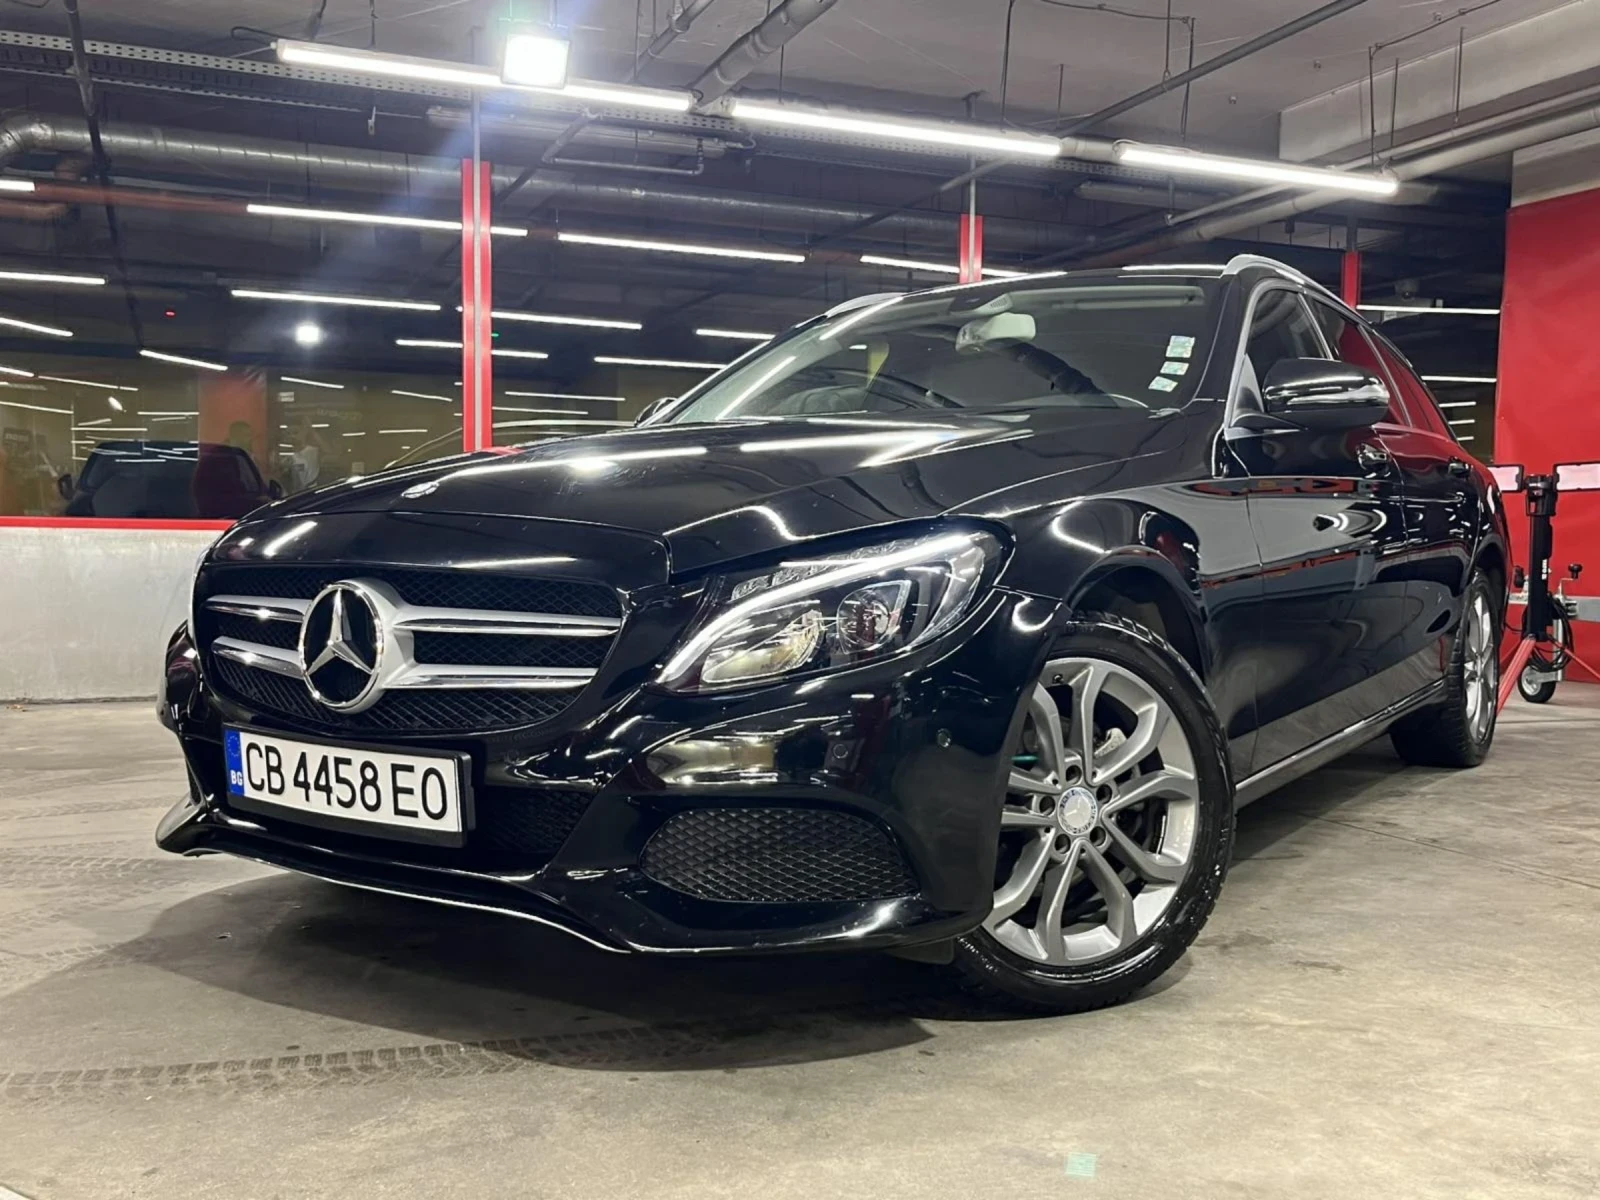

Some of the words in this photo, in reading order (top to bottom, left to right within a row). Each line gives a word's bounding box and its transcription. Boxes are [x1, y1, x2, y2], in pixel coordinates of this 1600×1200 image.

[230, 769, 243, 786] BG
[246, 742, 285, 796] CB
[293, 751, 382, 812] 4458
[390, 763, 448, 820] EO
